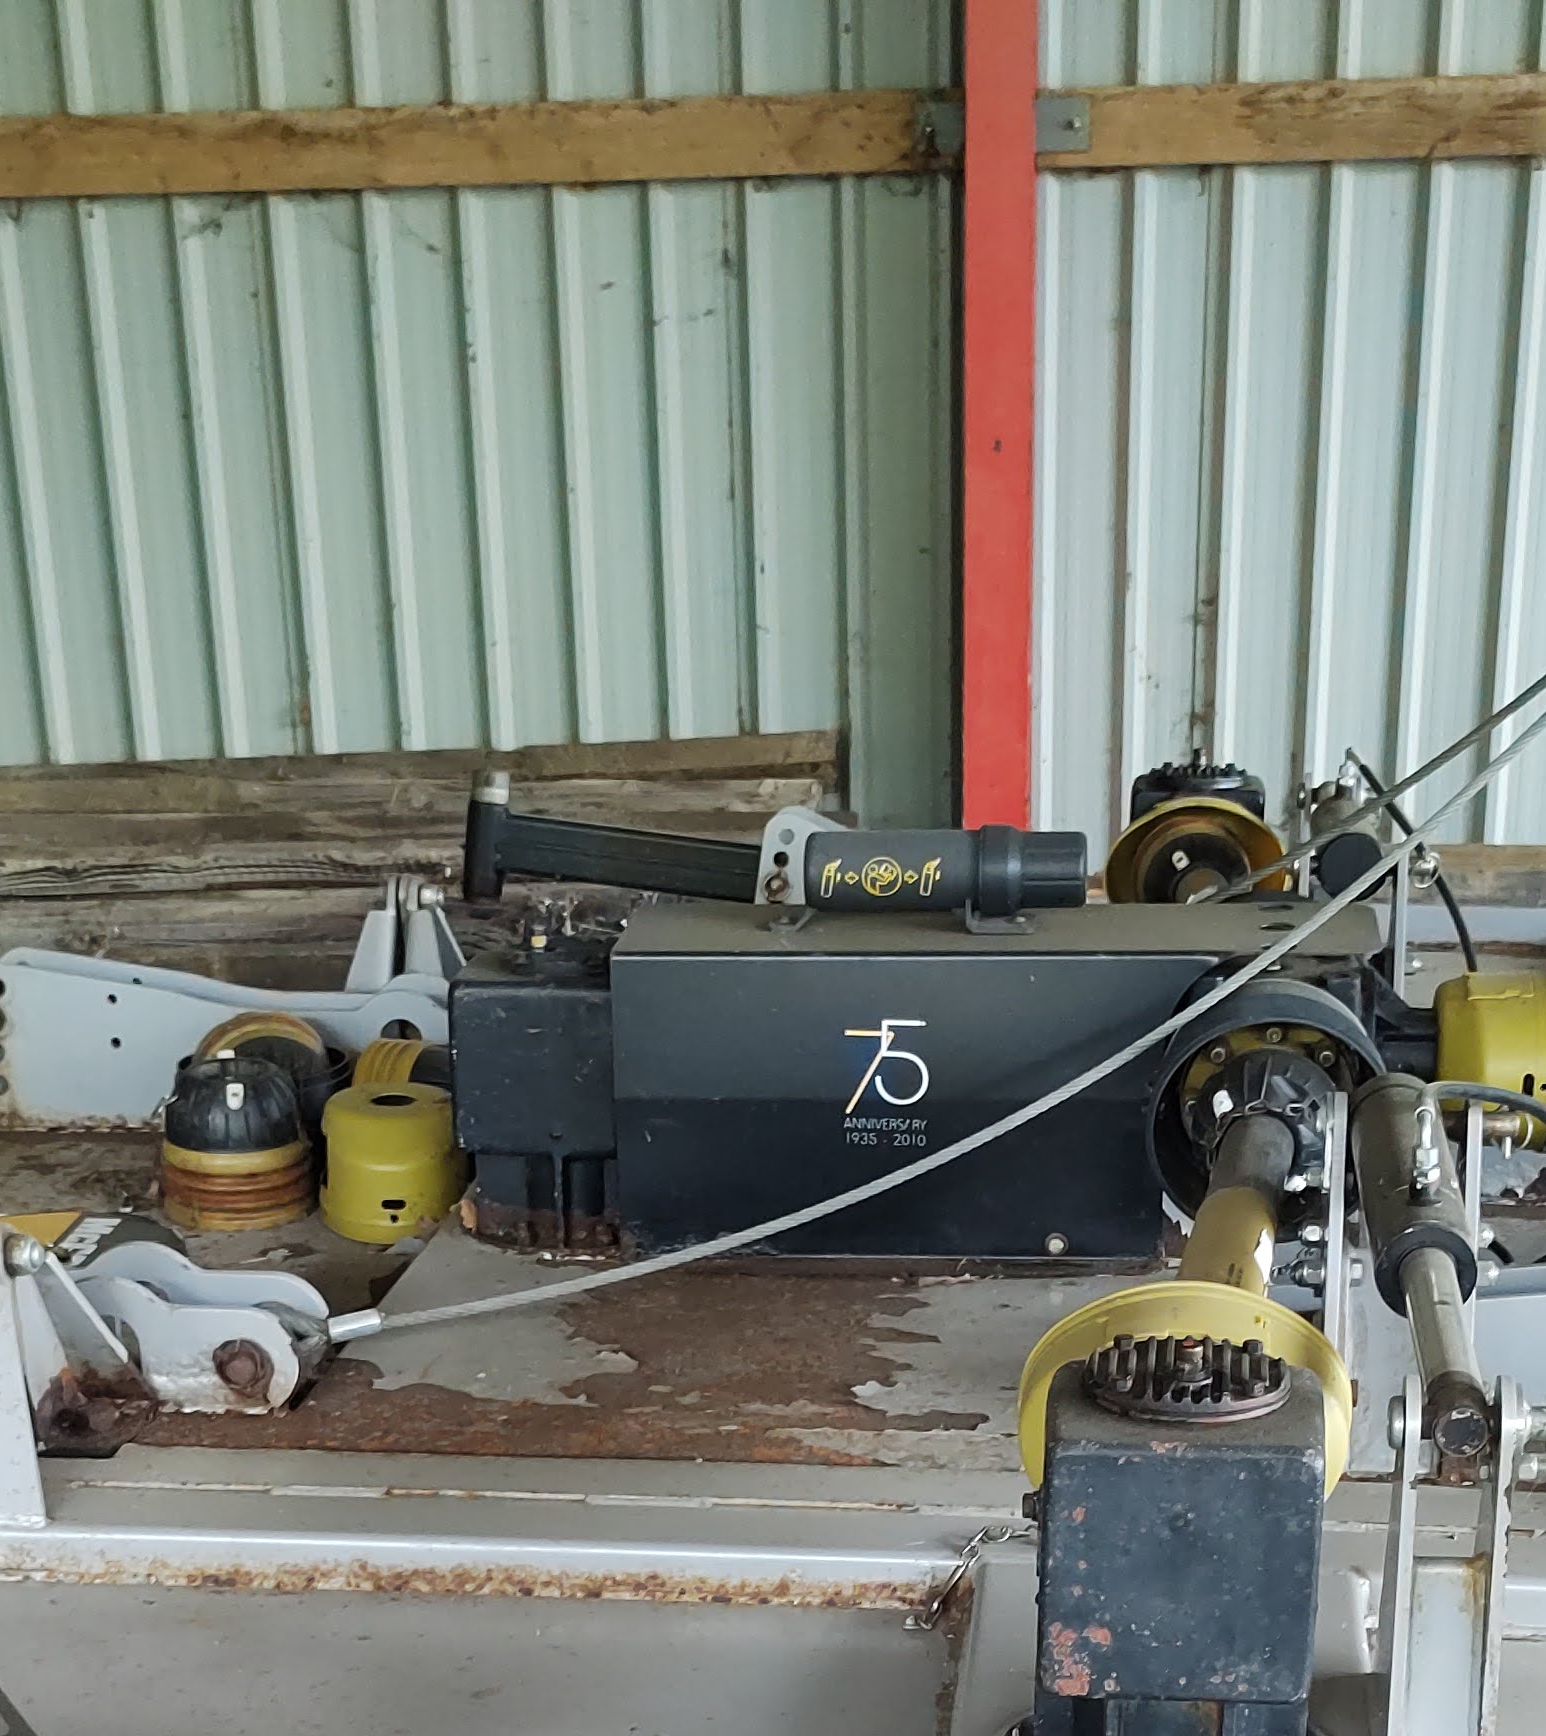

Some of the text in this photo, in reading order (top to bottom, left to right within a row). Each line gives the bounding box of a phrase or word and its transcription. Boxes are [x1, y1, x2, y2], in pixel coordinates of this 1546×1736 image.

[844, 1019, 929, 1115] 75
[846, 1132, 877, 1146] 1935
[892, 1133, 927, 1147] 2010
